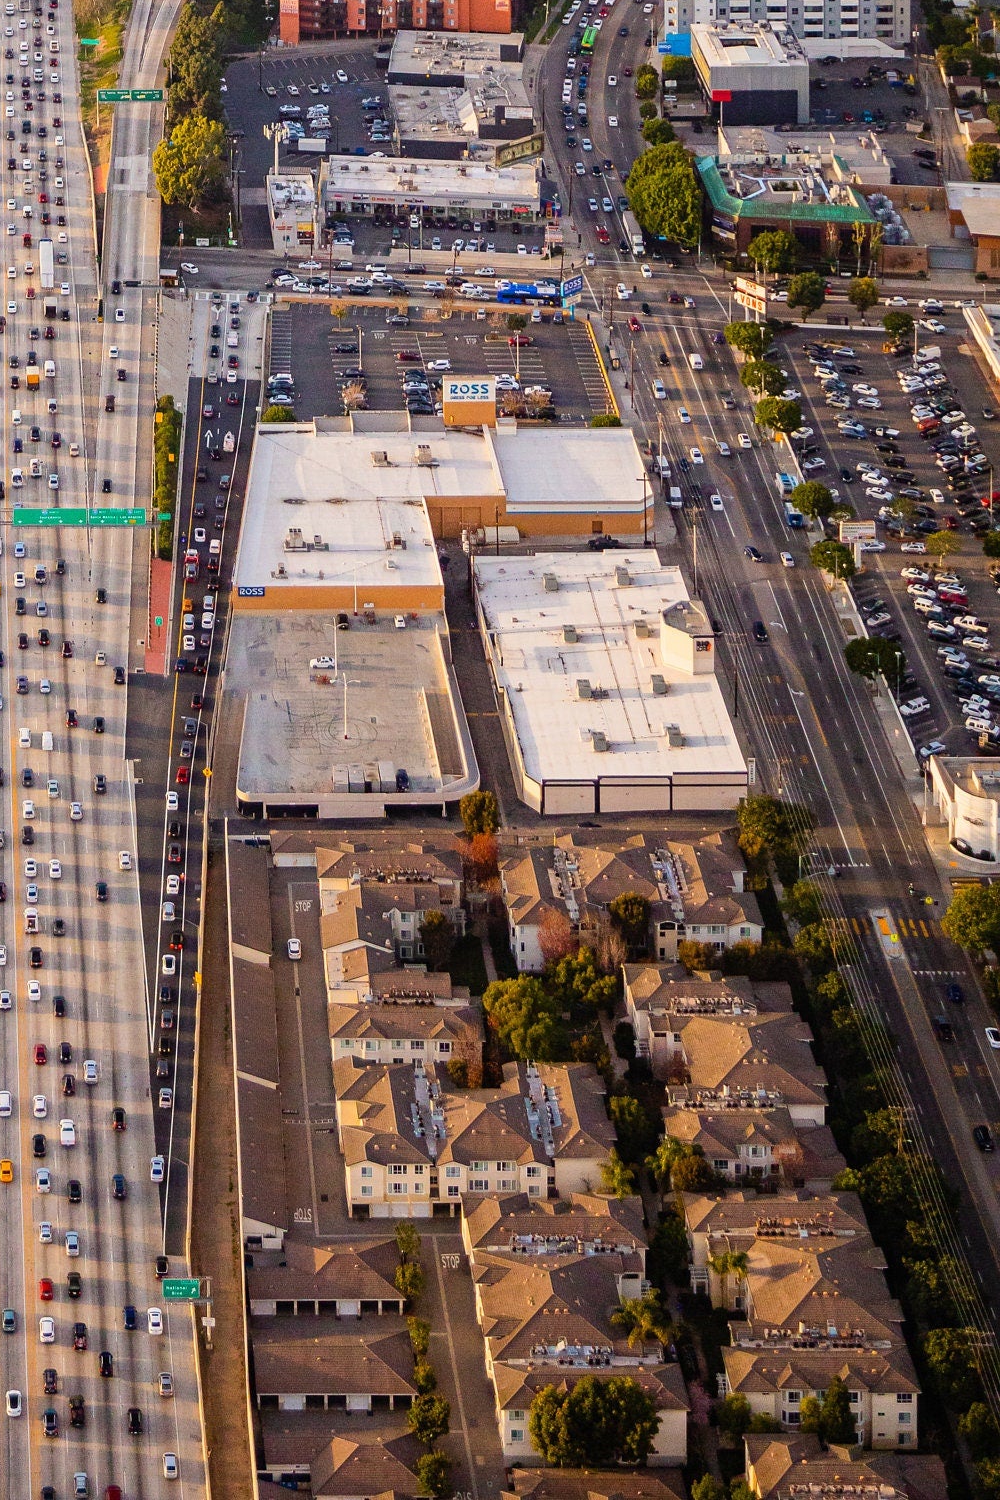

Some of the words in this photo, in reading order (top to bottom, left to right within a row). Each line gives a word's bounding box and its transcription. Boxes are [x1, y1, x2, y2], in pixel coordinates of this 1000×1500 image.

[564, 277, 582, 291] ROSS
[745, 280, 757, 290] CVS
[740, 294, 763, 311] VONS
[450, 384, 489, 394] ROSS
[239, 587, 264, 596] ROSS
[294, 901, 312, 913] STOP
[293, 1207, 312, 1221] STOP
